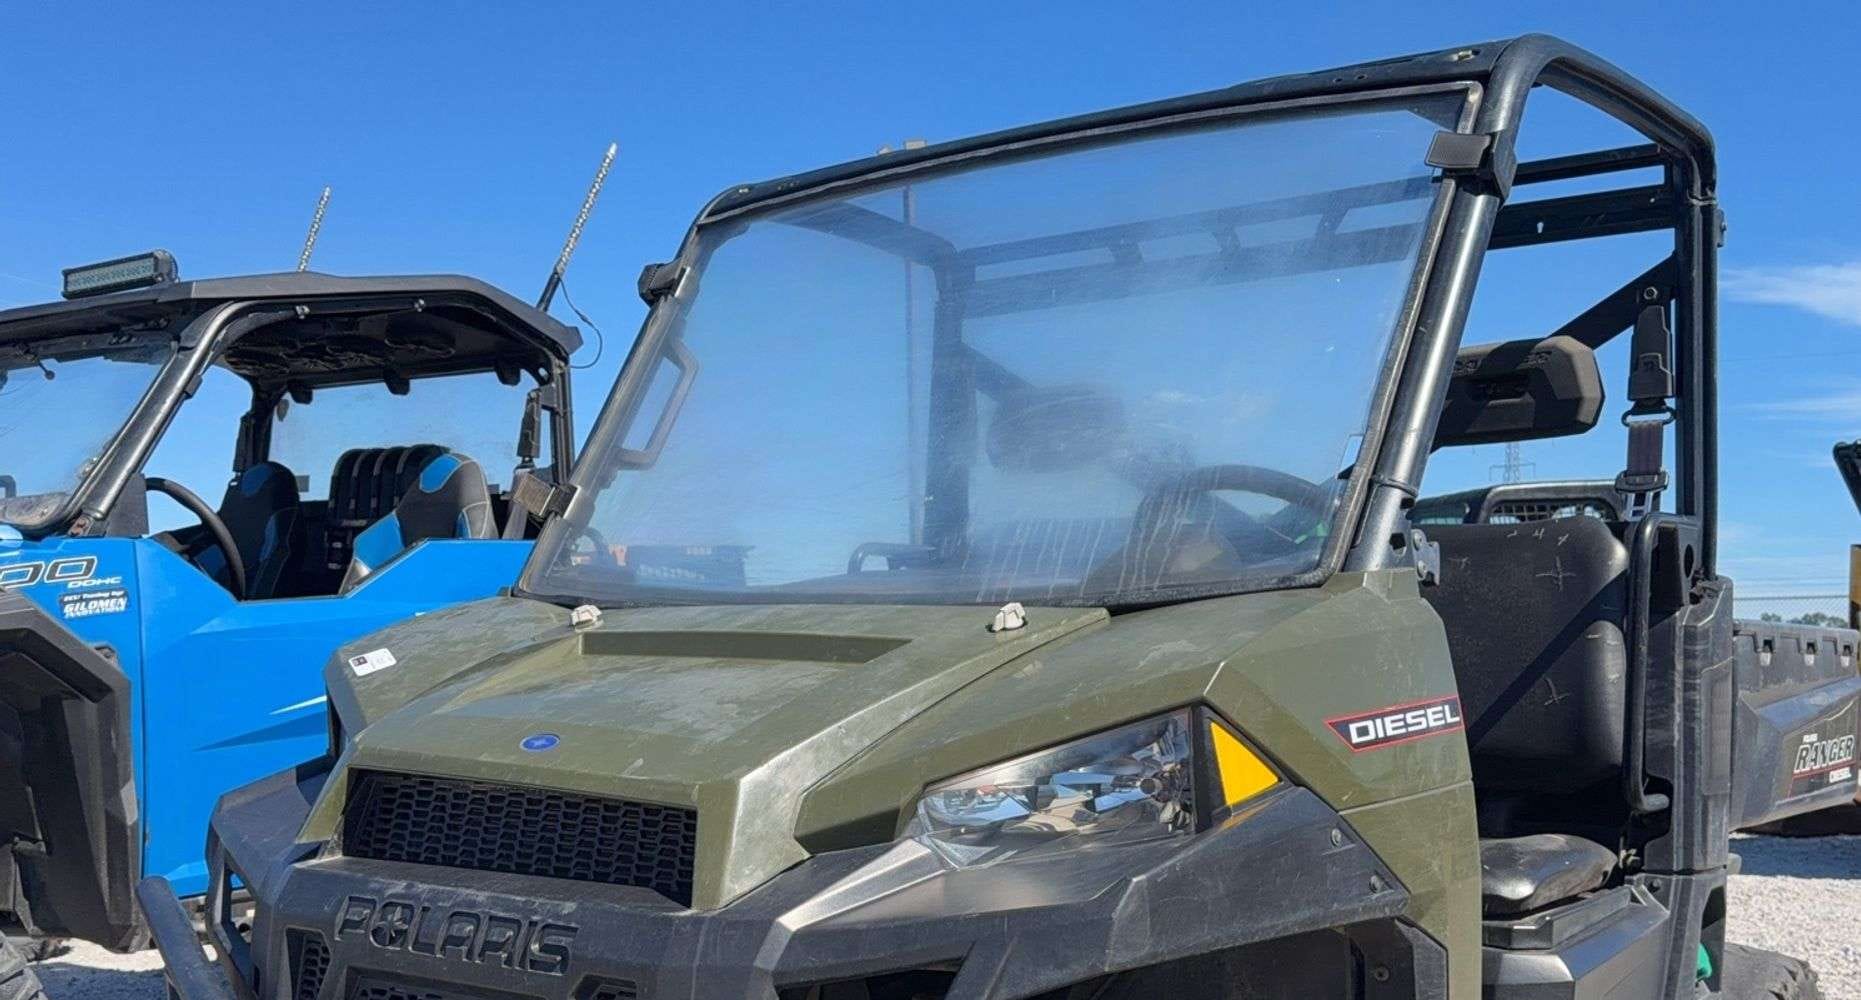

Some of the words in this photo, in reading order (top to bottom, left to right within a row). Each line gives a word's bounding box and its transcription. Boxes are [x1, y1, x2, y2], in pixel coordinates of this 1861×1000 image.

[67, 576, 122, 589] DOHC
[63, 597, 128, 613] GILOMEN
[1348, 704, 1461, 744] DIESEL
[1793, 734, 1855, 774] RANGER
[334, 895, 580, 976] POLARIS
